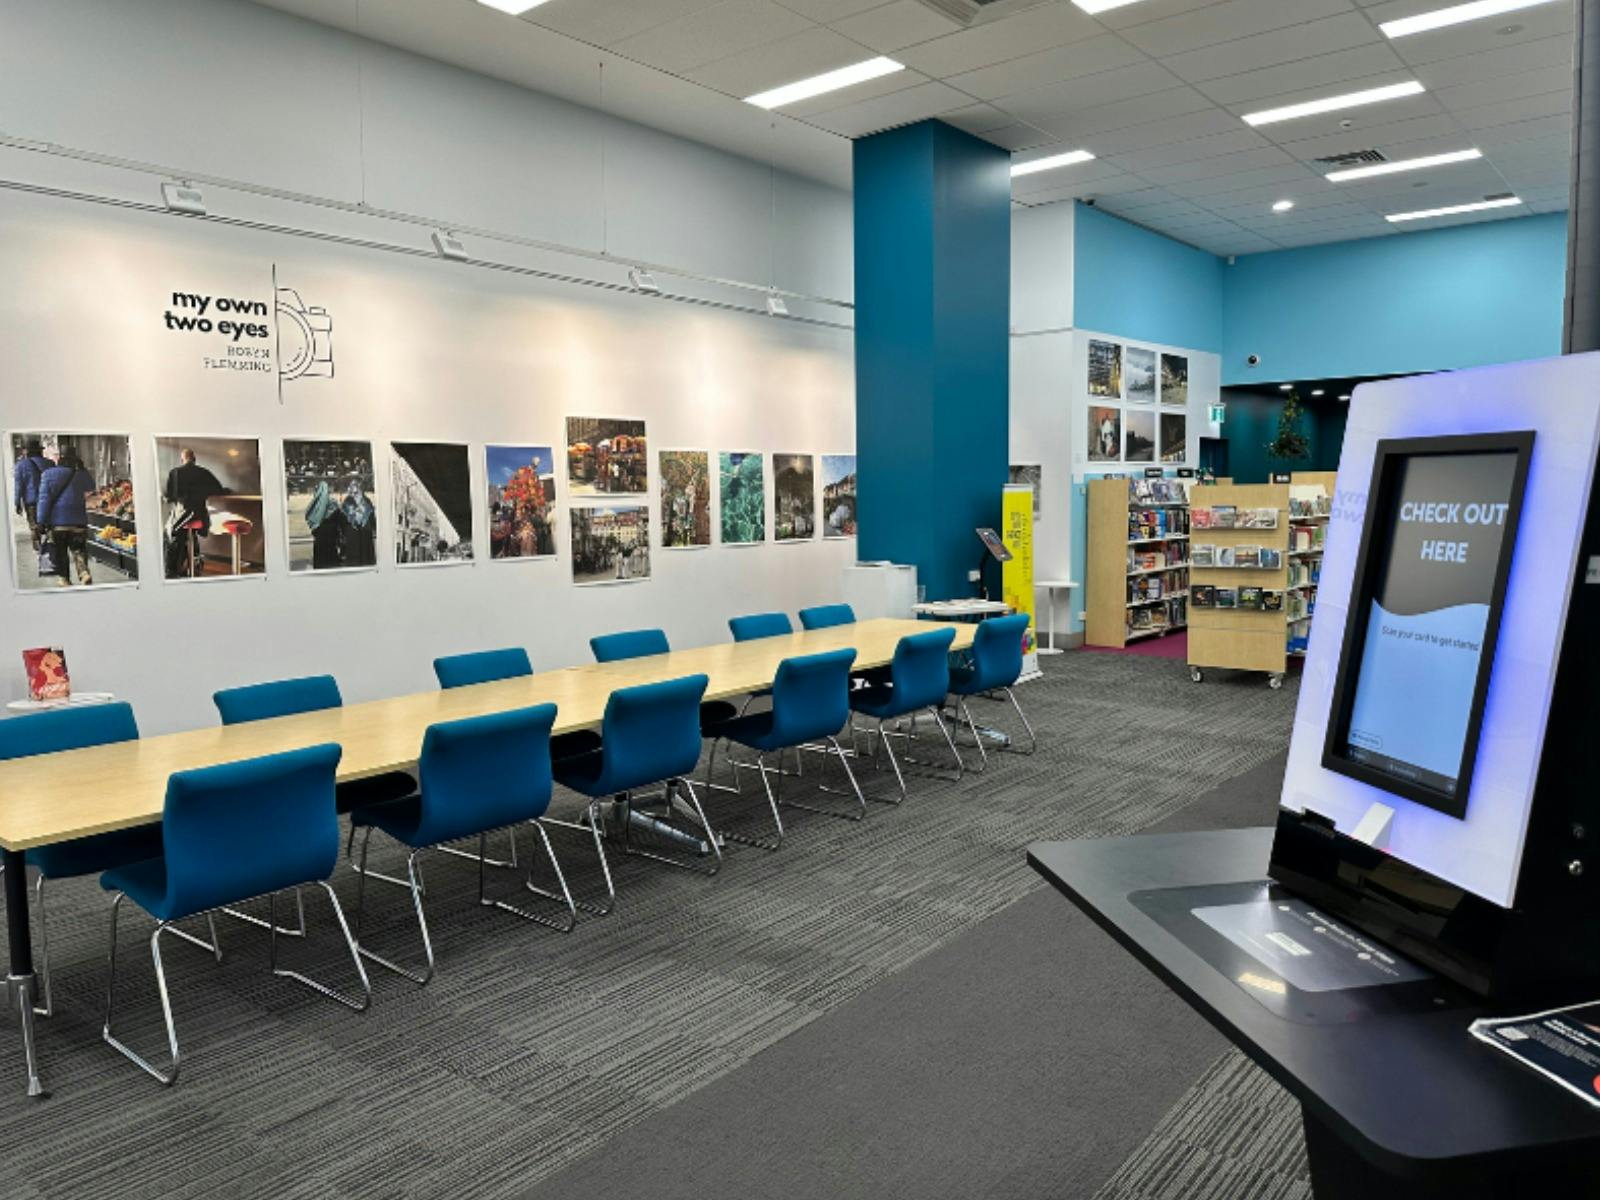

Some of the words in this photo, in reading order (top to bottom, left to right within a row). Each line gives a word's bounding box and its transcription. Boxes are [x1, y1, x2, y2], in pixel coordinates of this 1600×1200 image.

[172, 292, 211, 315] my
[215, 297, 268, 316] own
[164, 311, 213, 332] two
[217, 321, 269, 341] eyes
[1400, 501, 1460, 524] CHECK
[1463, 502, 1509, 526] OUT
[1420, 540, 1469, 563] HERE
[1382, 626, 1397, 635] Scan
[1398, 630, 1414, 639] your
[1415, 632, 1430, 642] card
[1439, 637, 1452, 647] get
